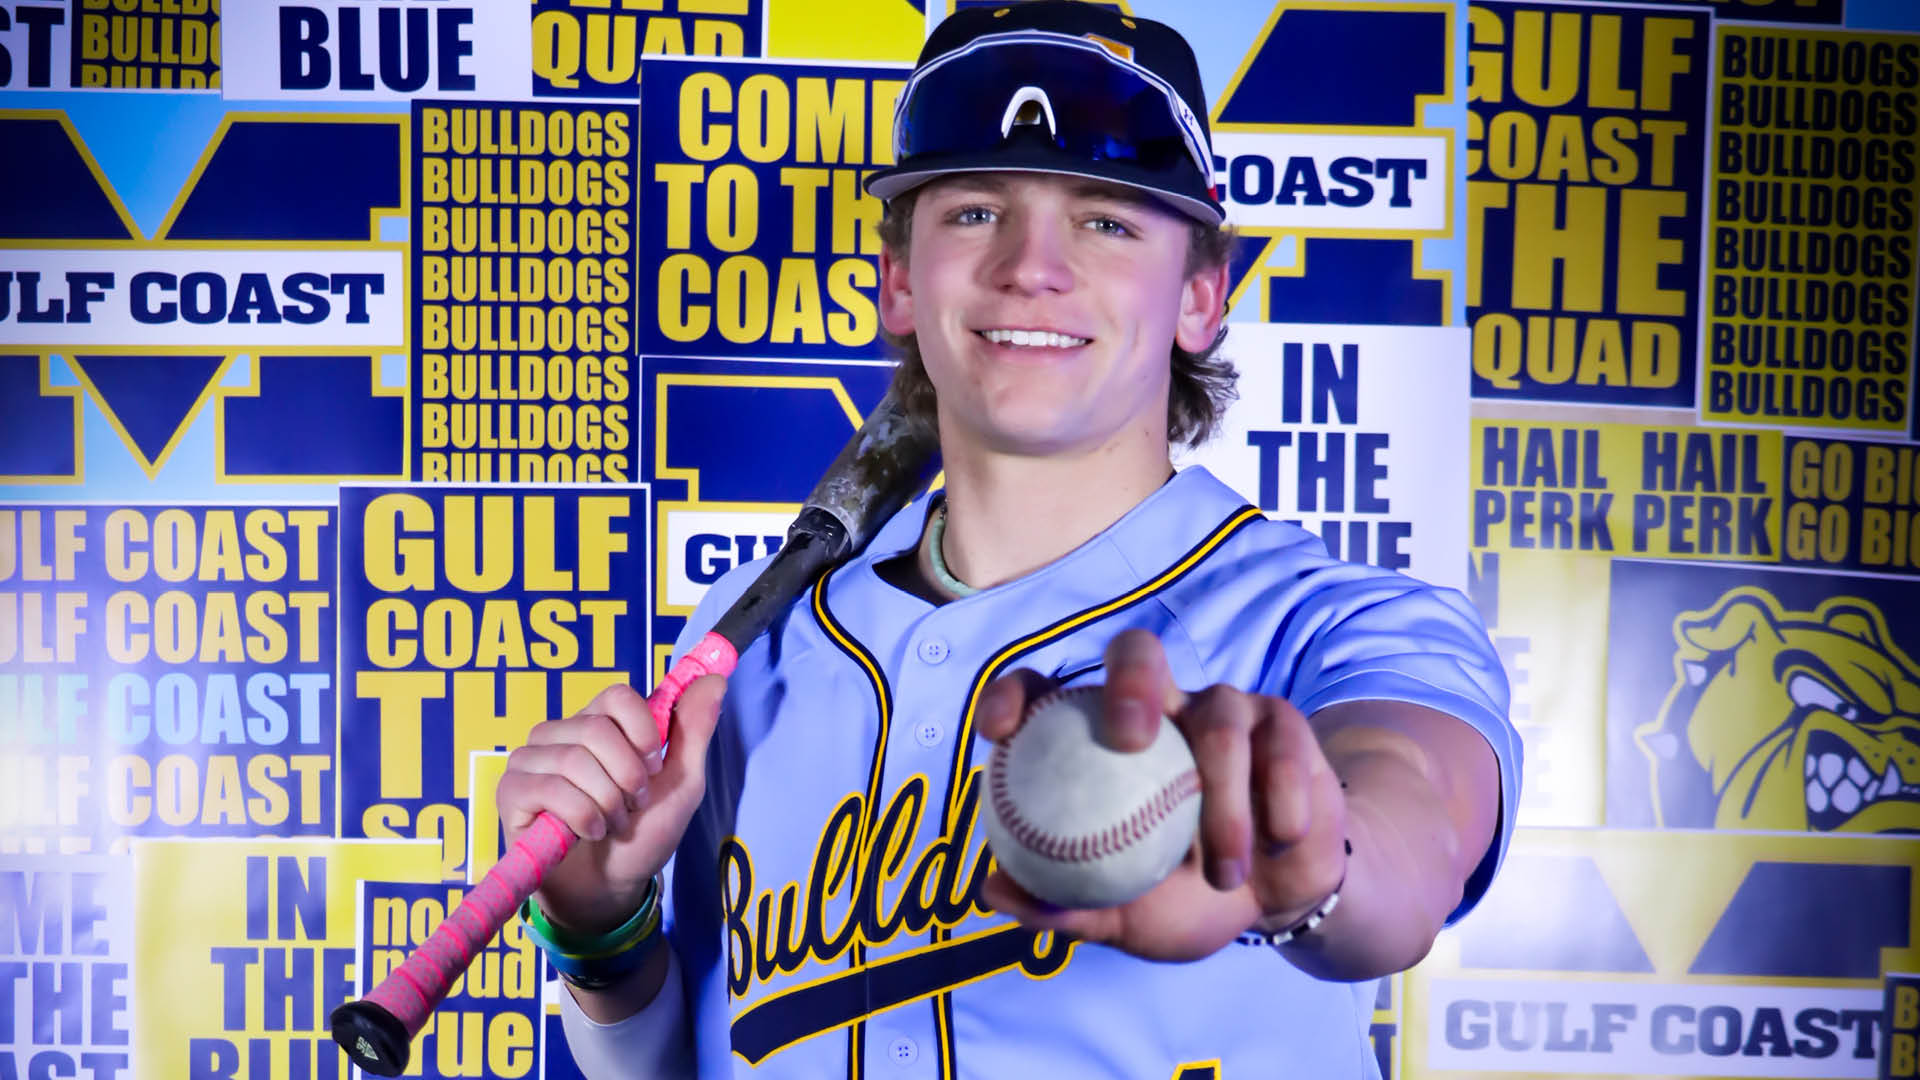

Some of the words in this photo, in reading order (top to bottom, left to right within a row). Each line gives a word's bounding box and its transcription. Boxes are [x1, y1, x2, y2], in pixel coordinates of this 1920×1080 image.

[278, 6, 476, 92] BLUE
[1723, 35, 1919, 88] BULLDOGS
[422, 108, 630, 158] BULLDOGS
[1721, 83, 1917, 136] BULLDOGS
[422, 157, 630, 206] BULLDOGS
[1719, 131, 1915, 184] BULLDOGS
[422, 206, 630, 256] BULLDOGS
[655, 163, 759, 252] TO
[780, 168, 884, 256] TH
[1717, 179, 1913, 232] BULLDOGS
[422, 255, 630, 304] BULLDOGS
[1715, 227, 1911, 280] BULLDOGS
[0, 271, 115, 324] LF
[129, 271, 385, 324] COAST
[422, 304, 630, 354] BULLDOGS
[657, 254, 878, 347] COAS
[1713, 275, 1909, 328] BULLDOGS
[422, 353, 630, 402] BULLDOGS
[1473, 313, 1681, 390] QUAD
[1711, 323, 1907, 376] BULLDOGS
[1282, 343, 1359, 425] IN
[1709, 371, 1905, 424] BULLDOGS
[422, 402, 630, 452] BULLDOGS
[1247, 431, 1390, 514] THE
[1482, 427, 1607, 490] HAIL
[1642, 431, 1767, 494] HAIL
[1790, 440, 1853, 502] GO
[1863, 446, 1920, 506] BI
[105, 509, 329, 582] COAST
[363, 493, 630, 593] GULF
[1474, 489, 1615, 552] PERK
[1632, 494, 1774, 556] PERK
[1786, 501, 1849, 563] GO
[106, 590, 329, 664] COAST
[366, 598, 628, 669] COAST
[107, 672, 330, 746] COAST
[108, 754, 331, 826] COAST
[246, 856, 327, 940] IN
[718, 764, 1076, 1003] Bulld
[211, 947, 356, 1032] THE
[402, 1011, 534, 1079] rue
[1444, 999, 1637, 1054] GULF
[1650, 1005, 1885, 1060] COAST
